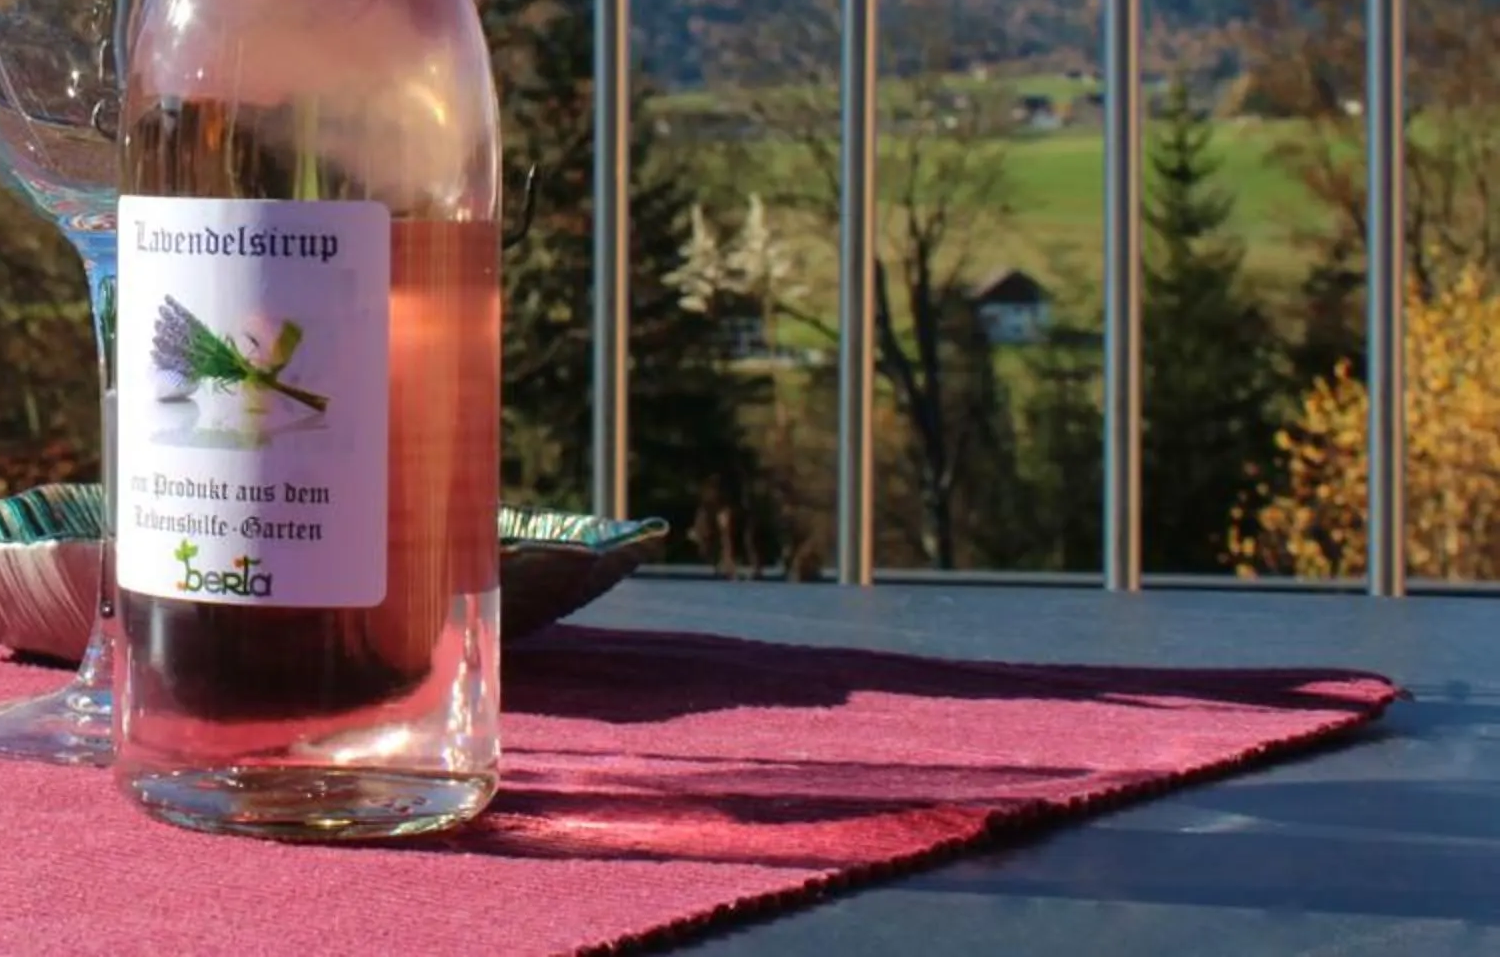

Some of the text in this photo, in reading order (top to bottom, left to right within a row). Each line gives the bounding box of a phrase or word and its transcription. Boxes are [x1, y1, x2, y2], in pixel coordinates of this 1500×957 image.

[134, 219, 338, 262] Lavendelsirup
[153, 471, 229, 501] Produkt
[235, 483, 276, 503] aus
[283, 482, 330, 505] dem
